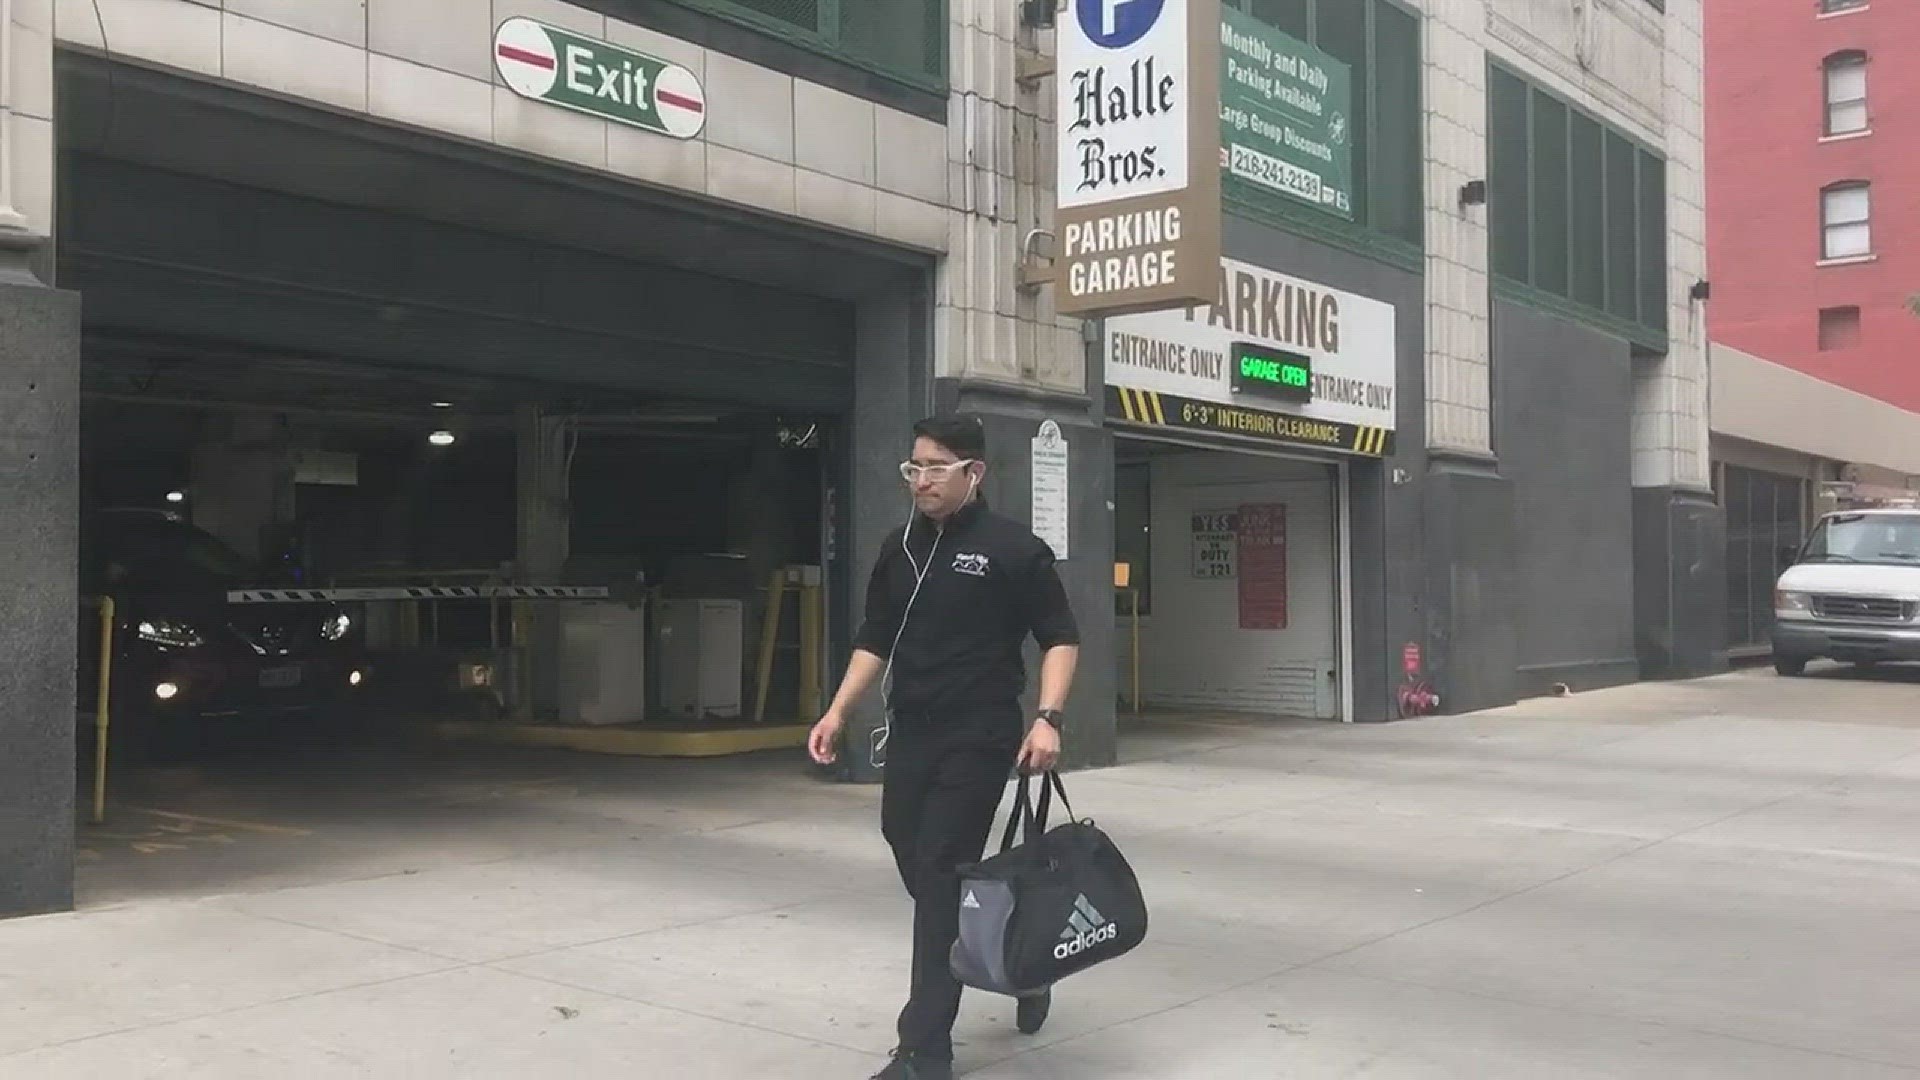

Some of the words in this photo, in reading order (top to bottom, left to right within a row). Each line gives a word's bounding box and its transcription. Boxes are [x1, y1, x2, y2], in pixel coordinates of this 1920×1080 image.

[565, 43, 648, 110] Exit
[1220, 22, 1271, 69] Monthly
[1274, 53, 1297, 77] and
[1299, 58, 1328, 95] Daily
[1068, 56, 1175, 133] Halle
[1228, 58, 1272, 99] Parking
[1274, 79, 1321, 116] Available
[1218, 101, 1248, 131] Large
[1250, 113, 1282, 145] Group
[1284, 126, 1332, 161] Discounts
[1076, 137, 1166, 193] Bros.
[1065, 206, 1182, 256] PARKING
[1069, 250, 1176, 296] GARAGE
[1185, 265, 1339, 353] ARKING
[1111, 331, 1186, 376] ENTRANCE
[1190, 346, 1224, 381] ONLY
[1241, 356, 1280, 382] GARAGE
[1281, 365, 1308, 387] OPEN
[1366, 382, 1392, 410] ONLY
[1217, 408, 1274, 433] INTERIOR
[1276, 419, 1340, 443] CLEARANCE
[1200, 515, 1230, 531] YES
[1200, 549, 1230, 561] DUTY
[1053, 922, 1117, 960] adidas
